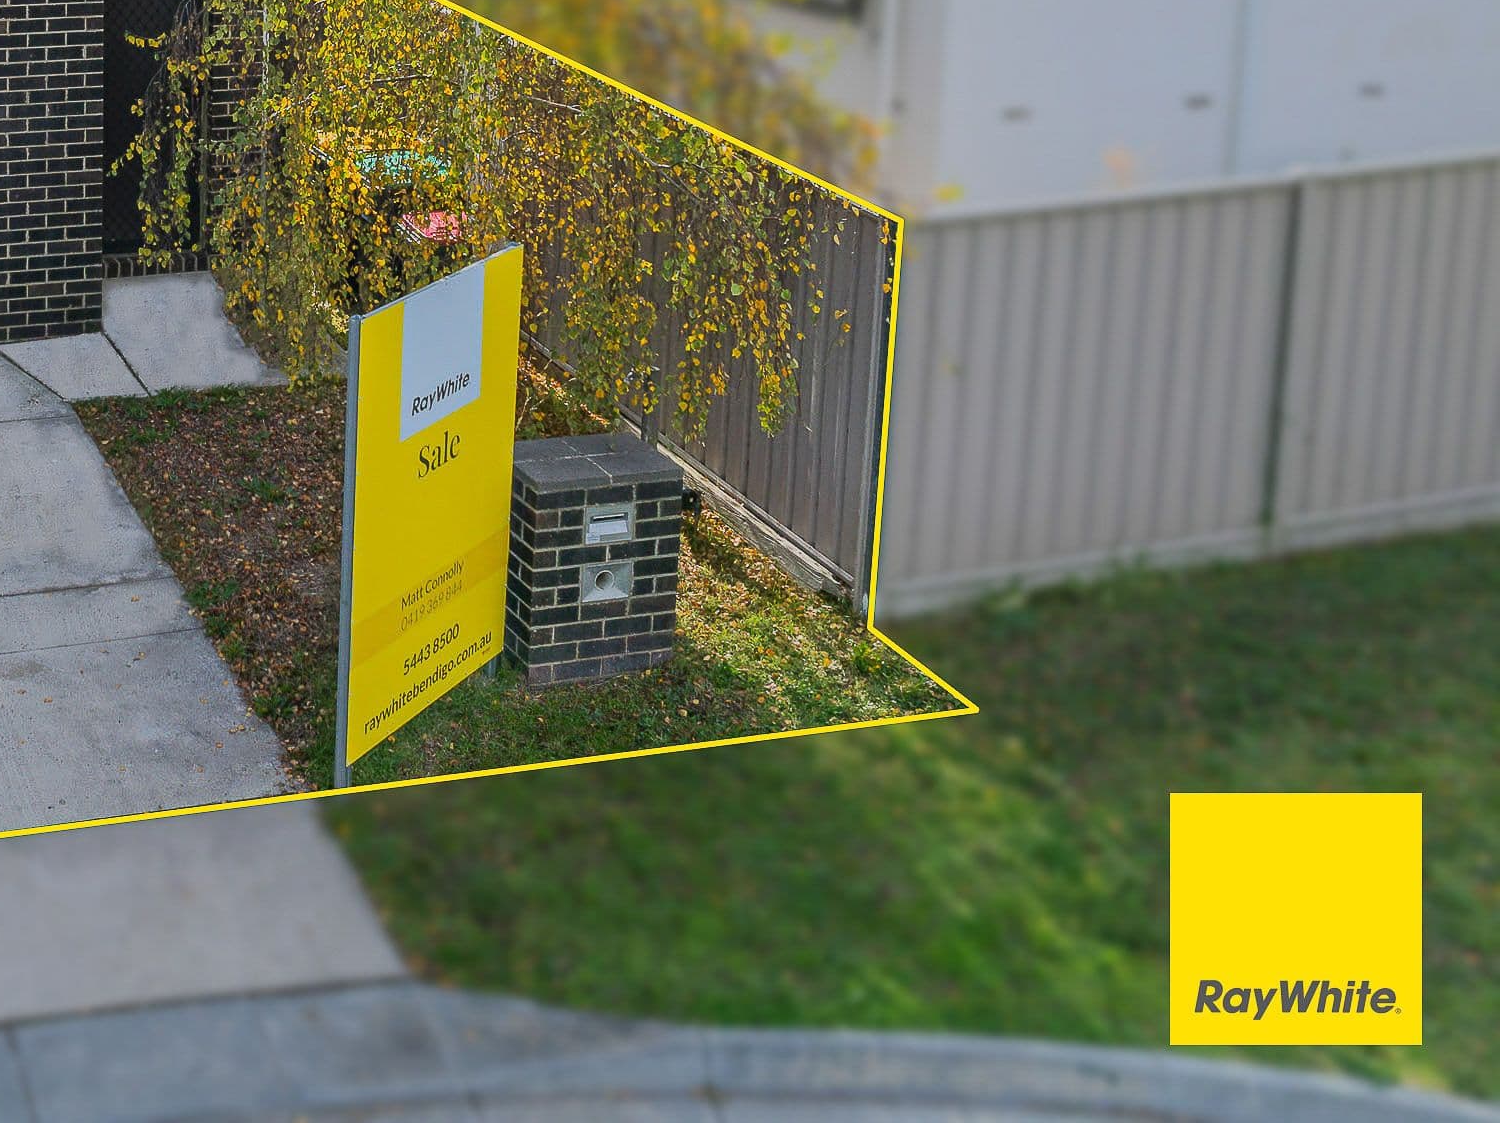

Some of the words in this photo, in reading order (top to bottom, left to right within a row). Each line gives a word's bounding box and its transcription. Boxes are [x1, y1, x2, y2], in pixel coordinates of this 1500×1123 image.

[417, 430, 461, 480] Sale
[401, 584, 424, 611] Matt
[425, 560, 465, 594] Connolly
[403, 643, 431, 676] 5443
[432, 623, 460, 654] 8500
[363, 631, 493, 735] raywhitebendigo.com.au
